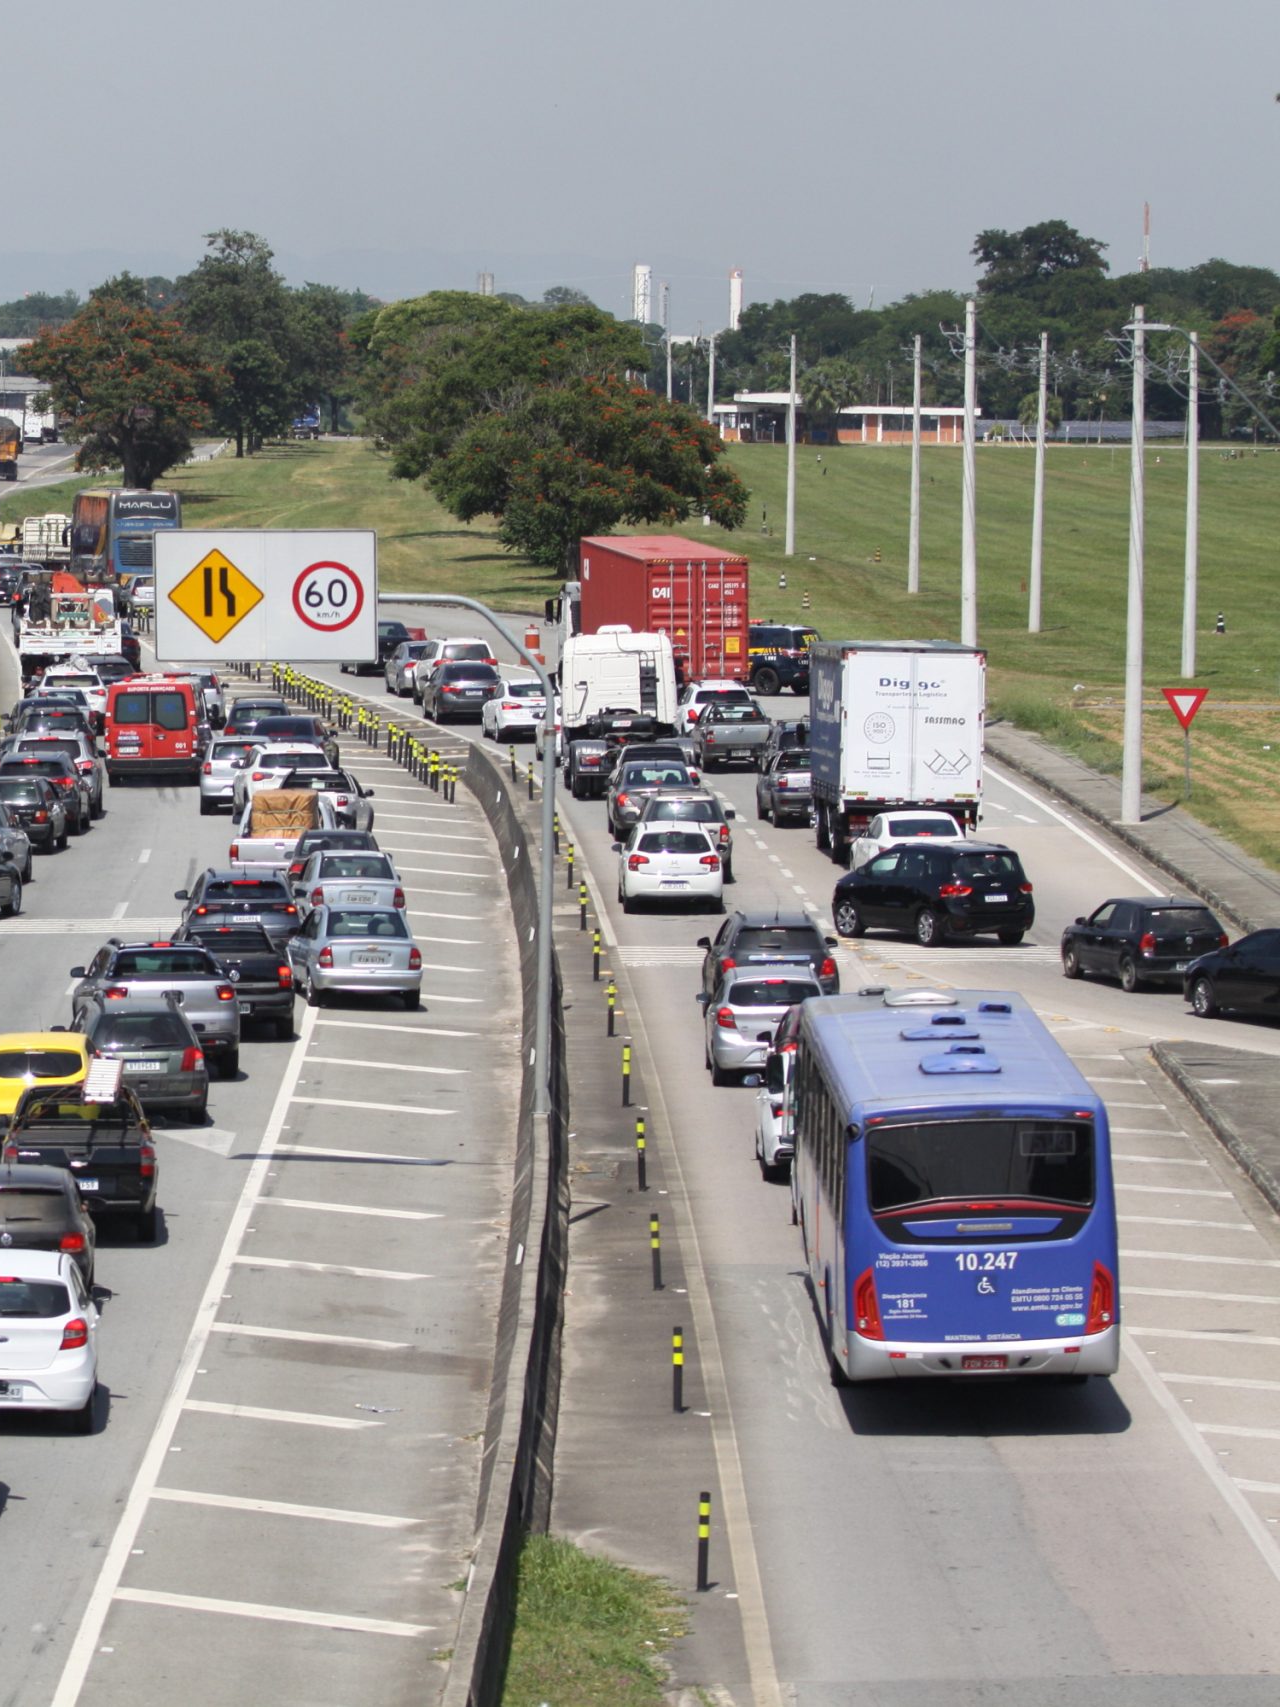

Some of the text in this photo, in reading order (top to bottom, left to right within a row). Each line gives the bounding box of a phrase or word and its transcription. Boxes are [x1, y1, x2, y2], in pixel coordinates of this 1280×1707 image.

[305, 578, 348, 608] 60
[652, 587, 671, 599] CAI
[316, 610, 341, 618] km/h
[955, 1252, 1018, 1271] 10.247
[896, 1299, 914, 1308] 181
[1011, 1295, 1032, 1303] EMTU
[986, 1332, 1021, 1340] DISTÂNCIA
